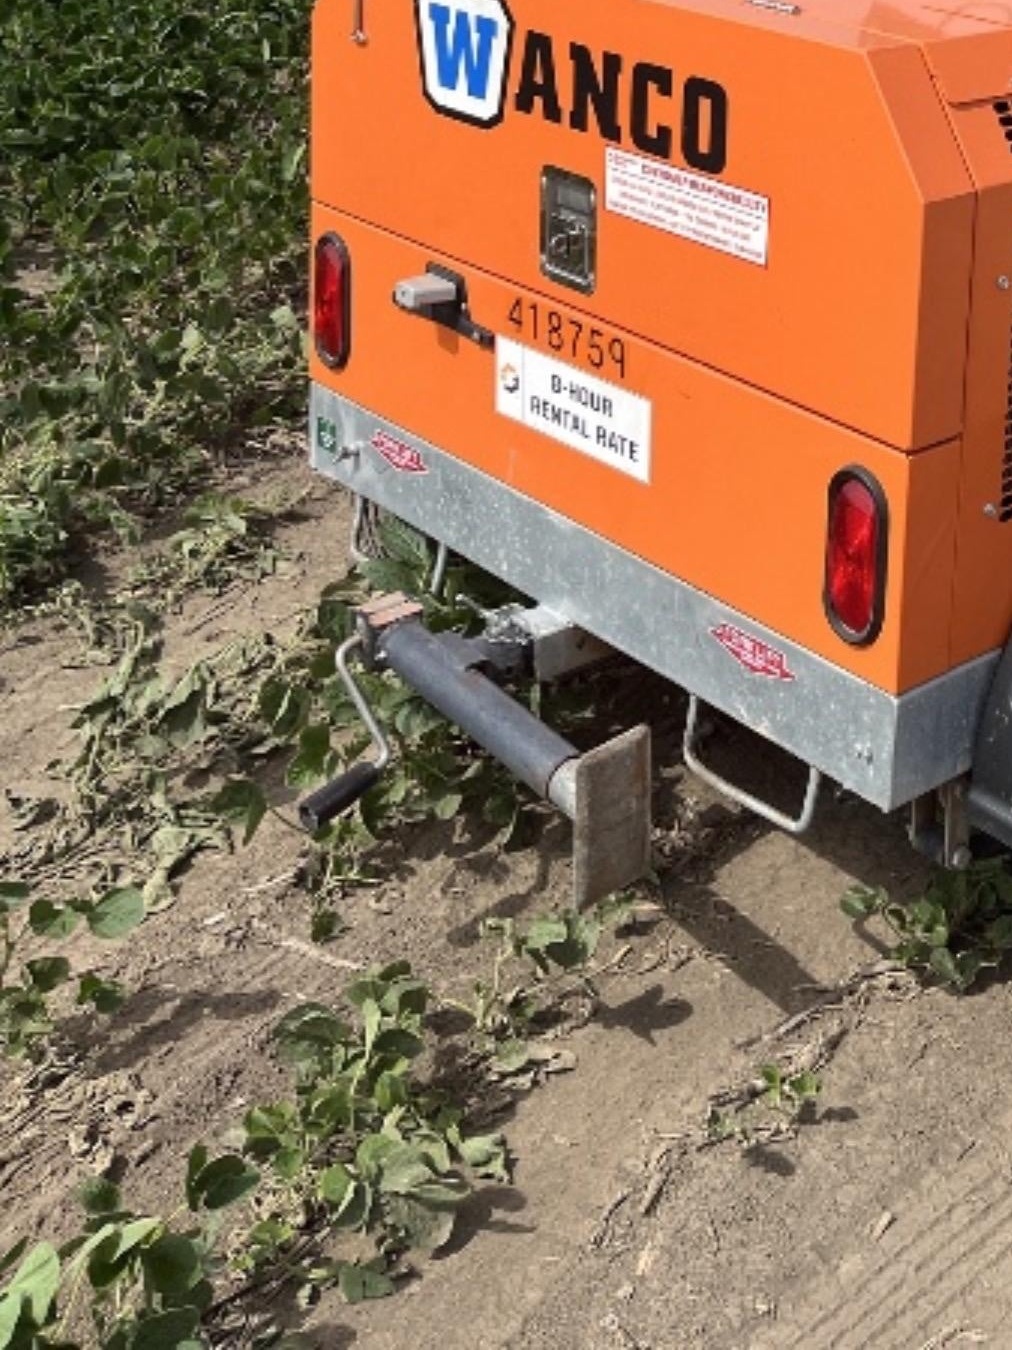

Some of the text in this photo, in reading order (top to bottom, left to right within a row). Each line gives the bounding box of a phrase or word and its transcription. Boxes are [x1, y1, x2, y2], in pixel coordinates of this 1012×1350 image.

[428, 2, 728, 175] WANCO
[508, 298, 626, 379] 418759
[530, 395, 640, 463] RENTAL RATE
